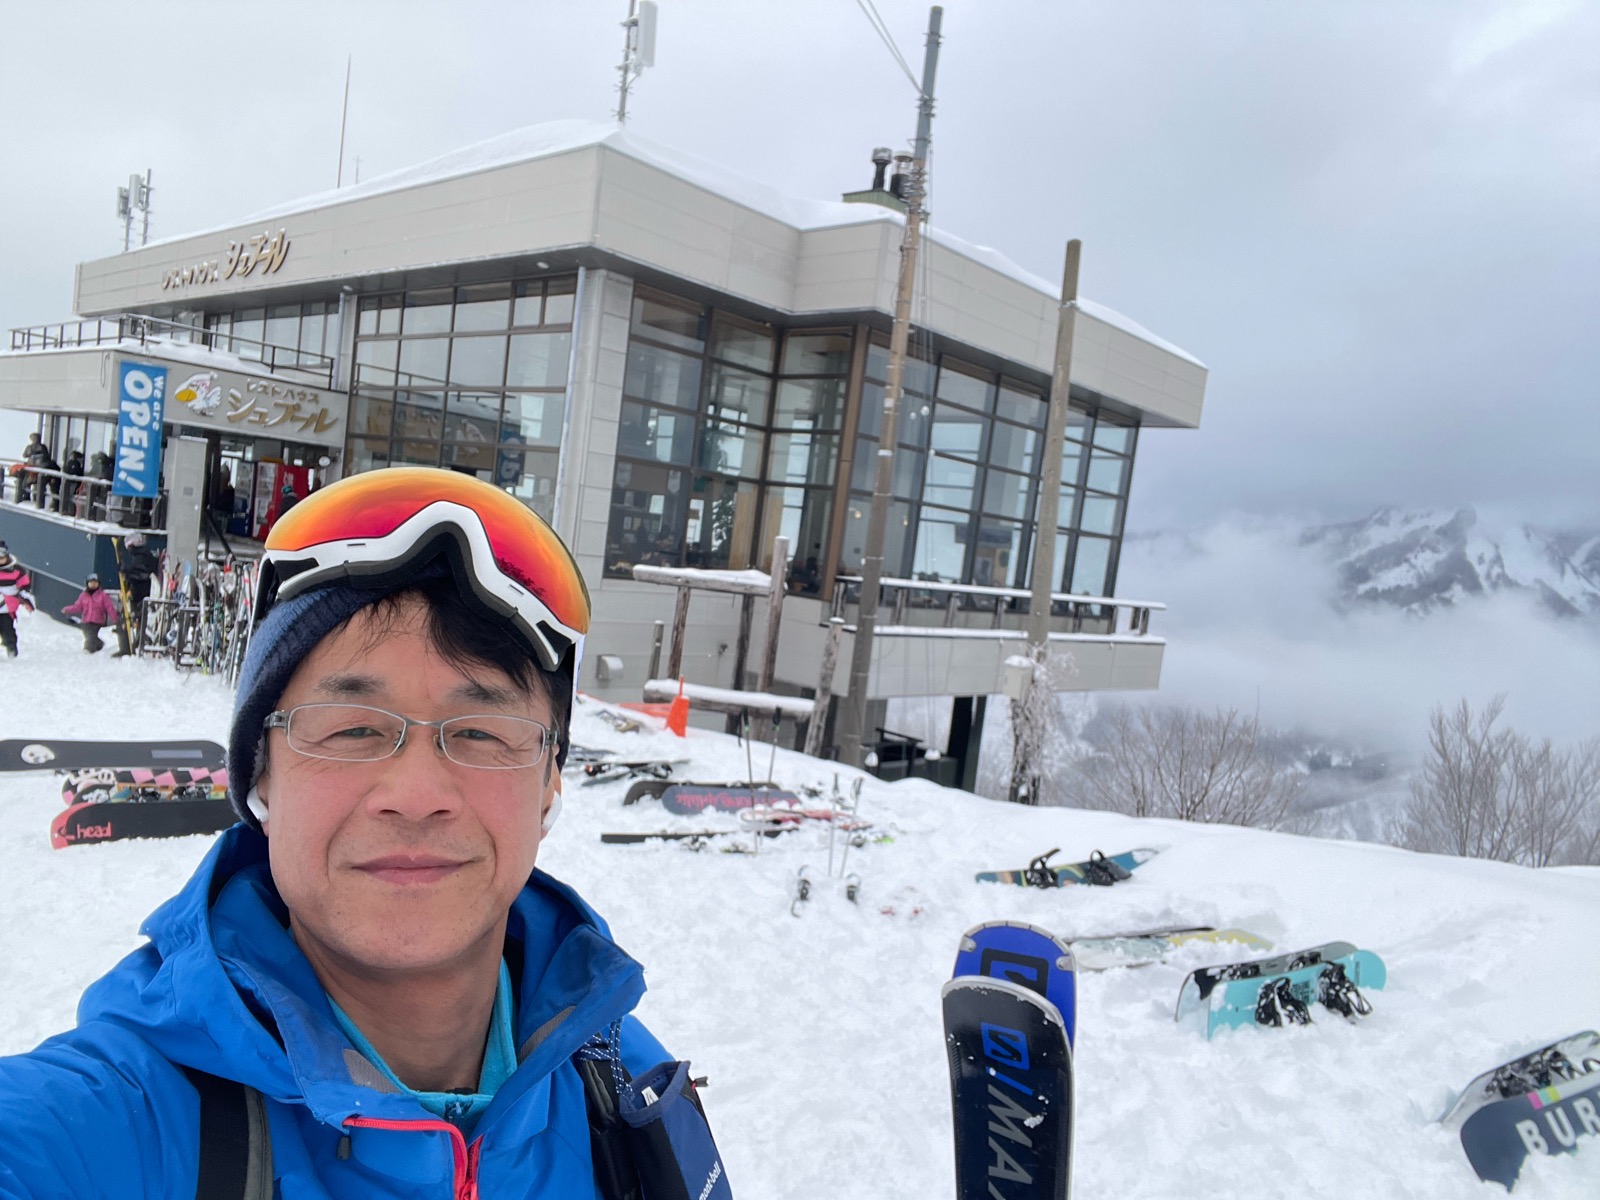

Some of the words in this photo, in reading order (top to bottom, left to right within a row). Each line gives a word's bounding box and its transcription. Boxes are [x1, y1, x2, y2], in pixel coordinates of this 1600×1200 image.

[153, 375, 164, 399] We
[247, 378, 320, 404] レストハウス
[152, 401, 163, 431] are
[117, 369, 153, 492] OPEN!
[77, 821, 112, 839] head
[1515, 1090, 1600, 1156] BUR
